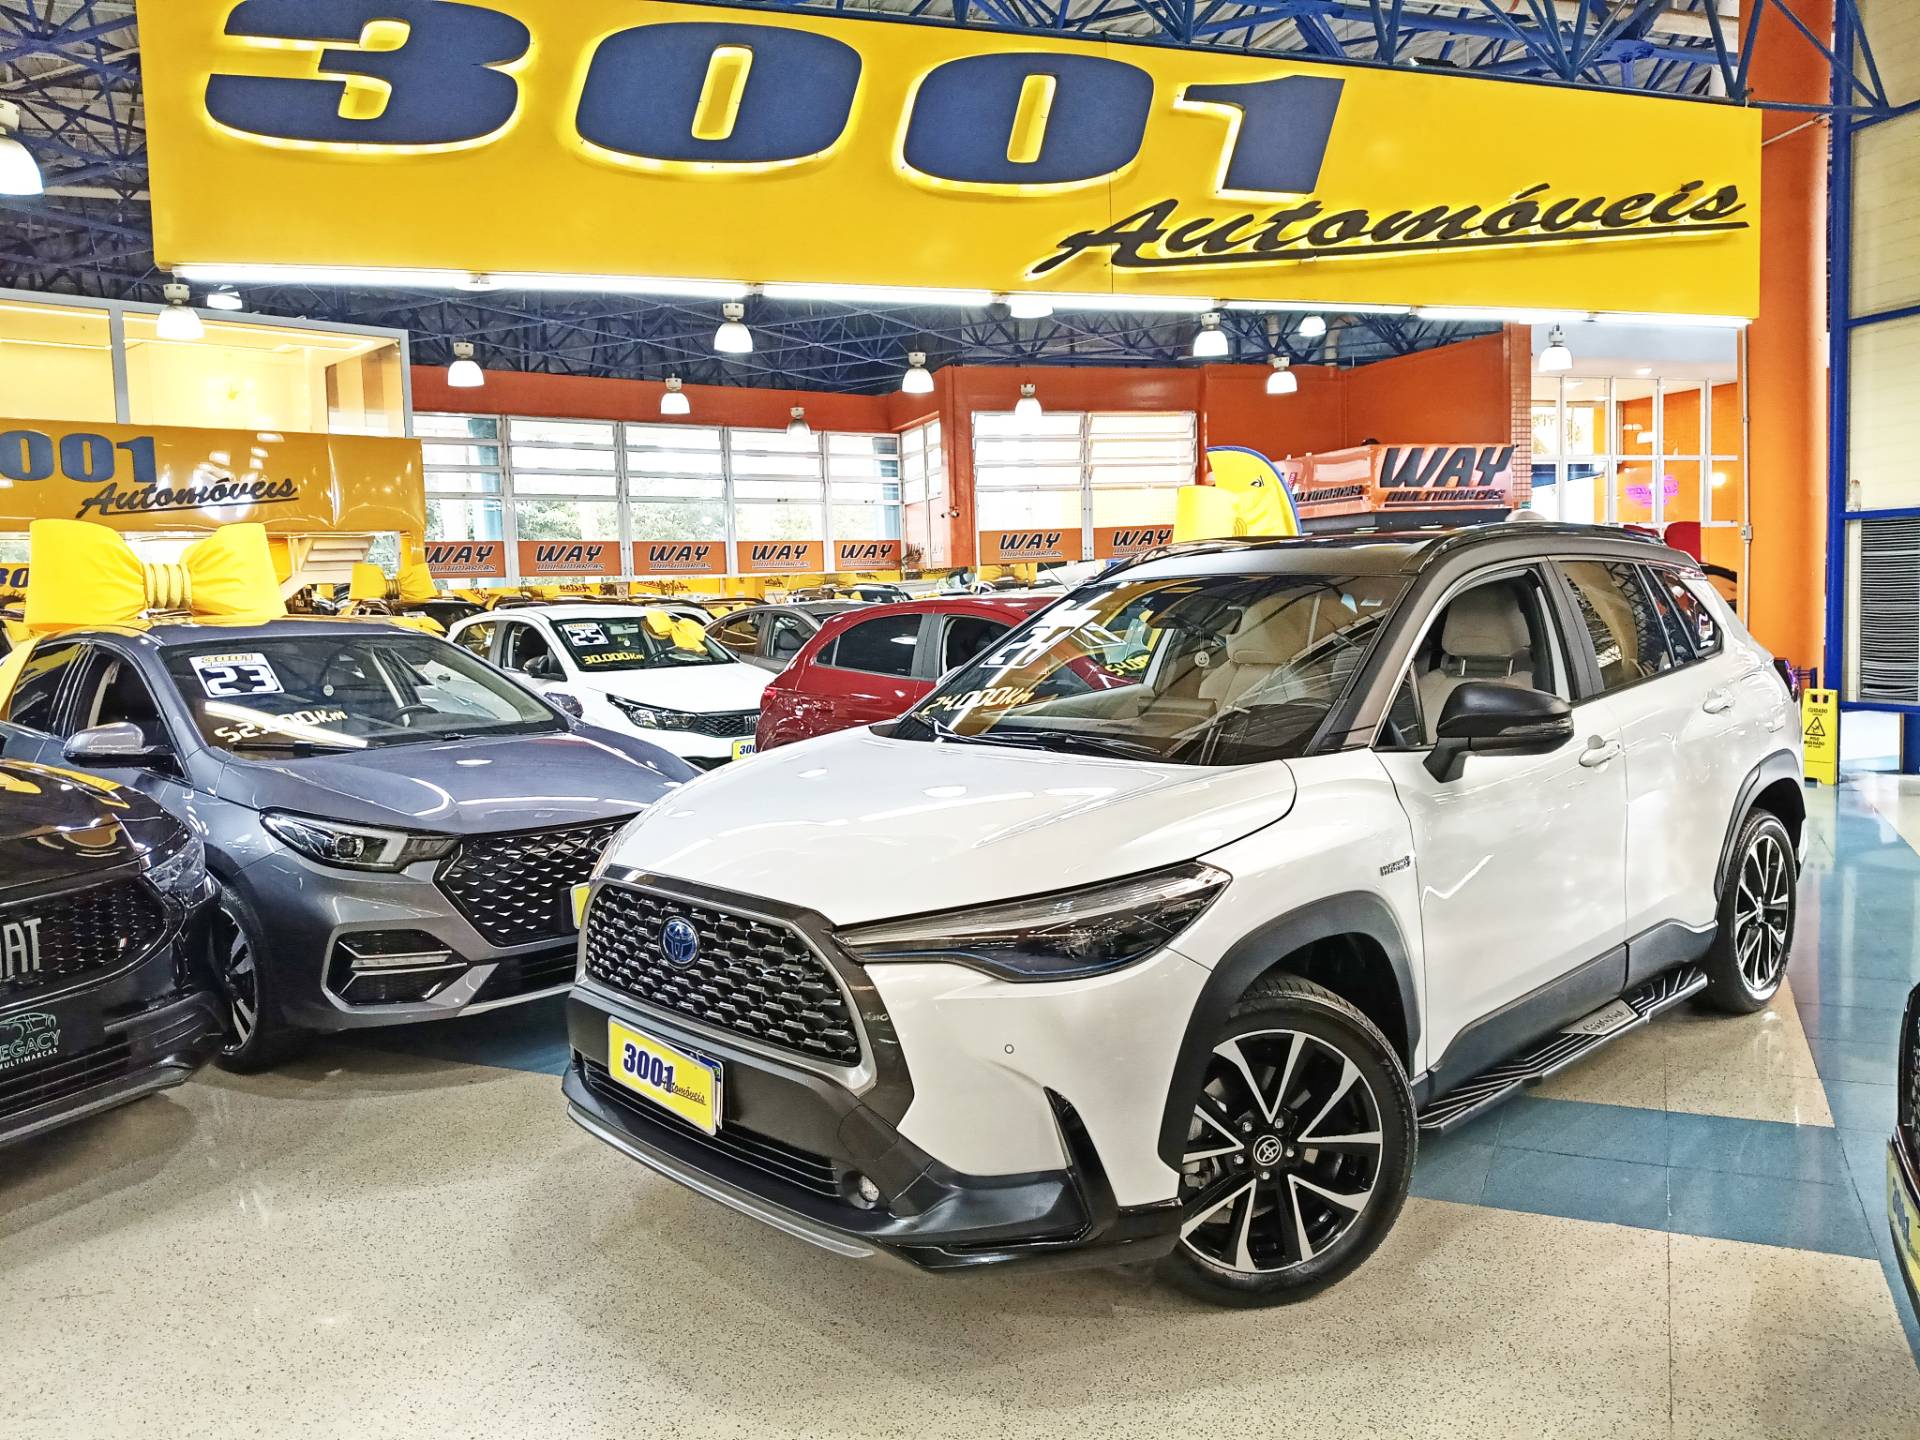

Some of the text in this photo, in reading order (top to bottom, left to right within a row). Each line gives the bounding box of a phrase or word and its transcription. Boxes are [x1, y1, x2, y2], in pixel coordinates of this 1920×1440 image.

[204, 0, 1343, 195] 3001
[1032, 181, 1749, 277] Automóveis
[1379, 447, 1514, 488] WAY
[75, 477, 299, 519] Automóveis
[999, 532, 1061, 550] WAY
[1113, 529, 1172, 547] WAY
[425, 545, 495, 564] WAY
[536, 544, 604, 562] WAY
[649, 544, 711, 562] WAY
[751, 544, 809, 560] WAY
[841, 543, 895, 560] WAY
[569, 629, 606, 645] 25
[203, 664, 280, 696] 23
[0, 917, 42, 979] AT
[0, 1029, 61, 1062] EGACY
[623, 1042, 674, 1094] 3001
